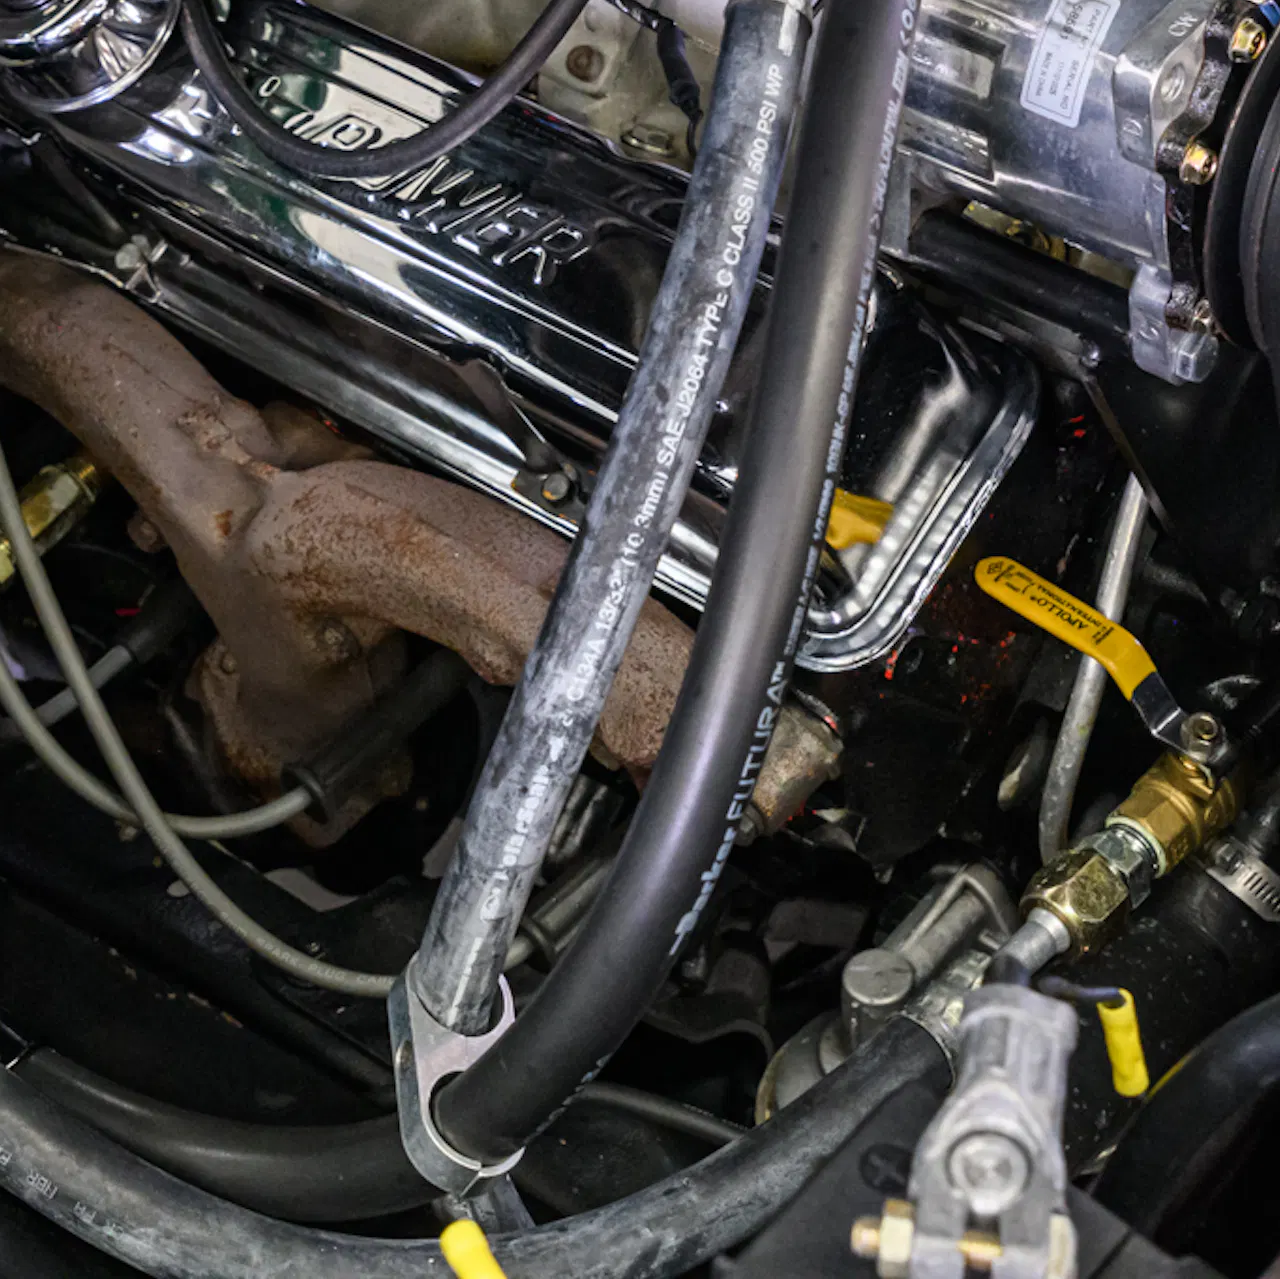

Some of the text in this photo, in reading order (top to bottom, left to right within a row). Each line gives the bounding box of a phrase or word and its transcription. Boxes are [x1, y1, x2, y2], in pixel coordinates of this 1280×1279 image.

[762, 61, 787, 99] WP
[1063, 59, 1080, 93] SERIAL
[755, 99, 779, 135] PSI
[745, 135, 770, 176] 500
[720, 192, 755, 267] CLASS
[712, 265, 736, 289] C
[672, 350, 709, 419] J2064
[655, 416, 686, 469] SAE
[305, 961, 347, 983] PLUG
